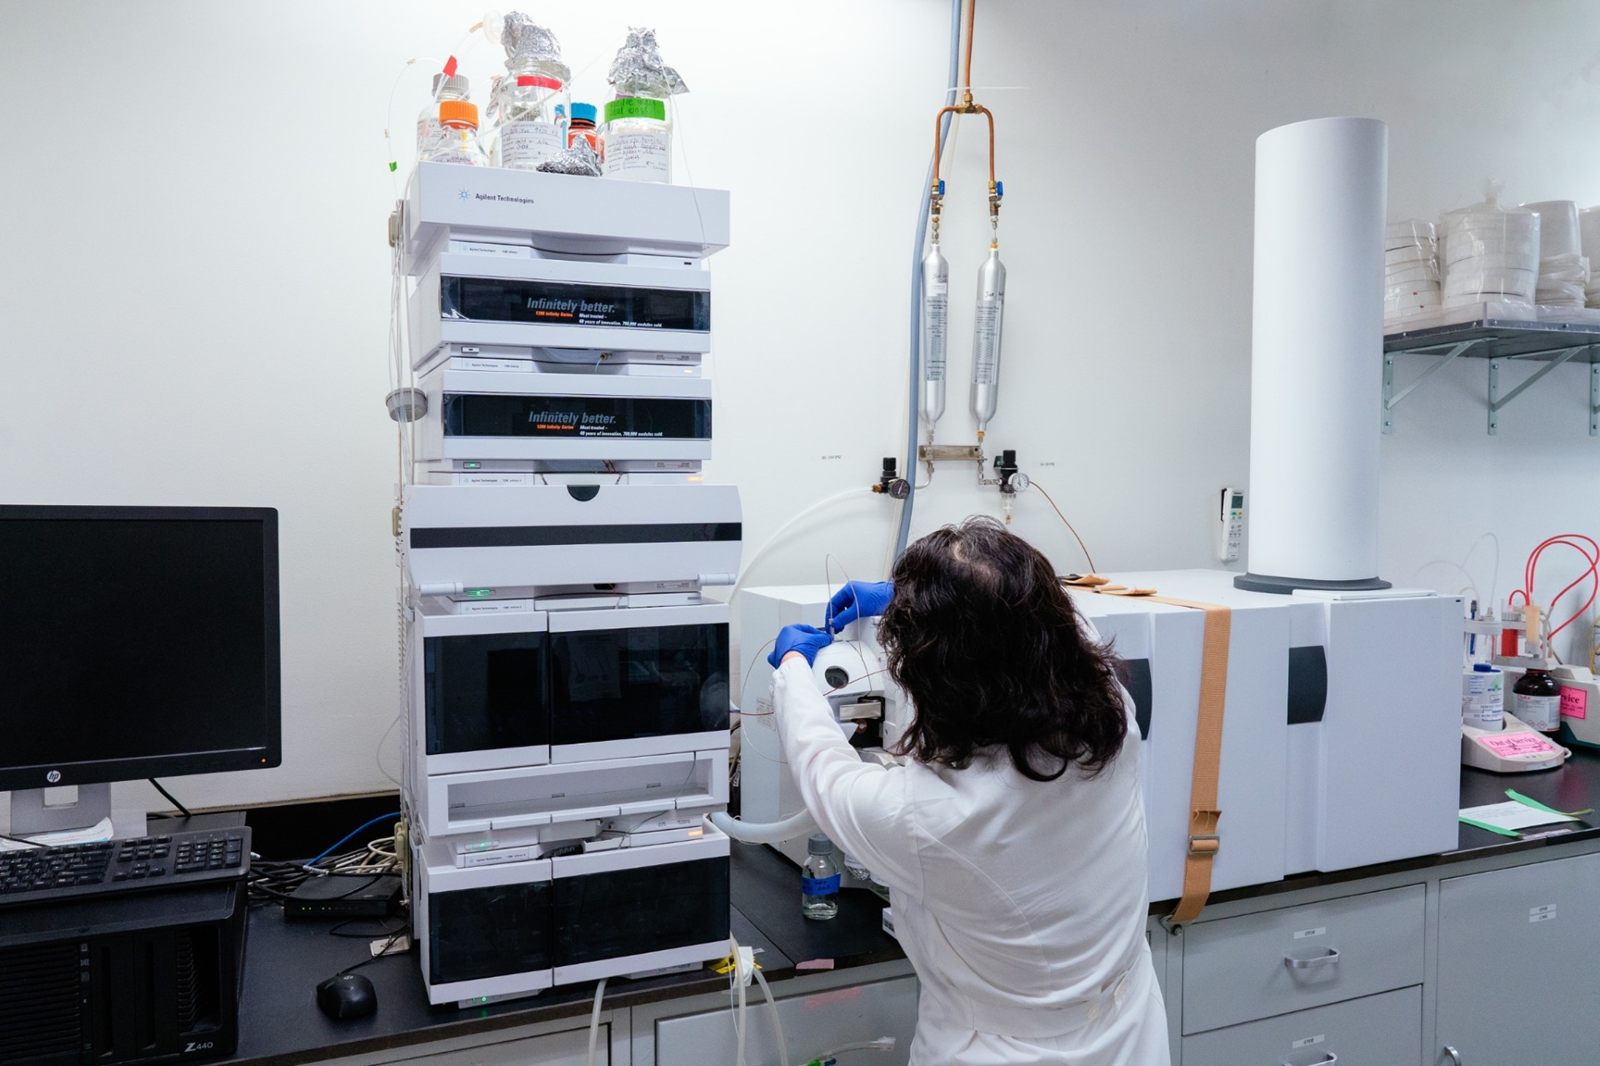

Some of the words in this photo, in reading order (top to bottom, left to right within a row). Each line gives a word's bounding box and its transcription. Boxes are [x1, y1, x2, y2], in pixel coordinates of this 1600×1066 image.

[475, 193, 496, 201] Agilent
[497, 194, 535, 204] Technologies
[527, 297, 578, 313] Infinitely
[580, 300, 616, 313] better.
[528, 411, 579, 426] Infinitely
[581, 412, 617, 425] better.
[48, 770, 60, 782] hp
[184, 1041, 214, 1053] Z440
